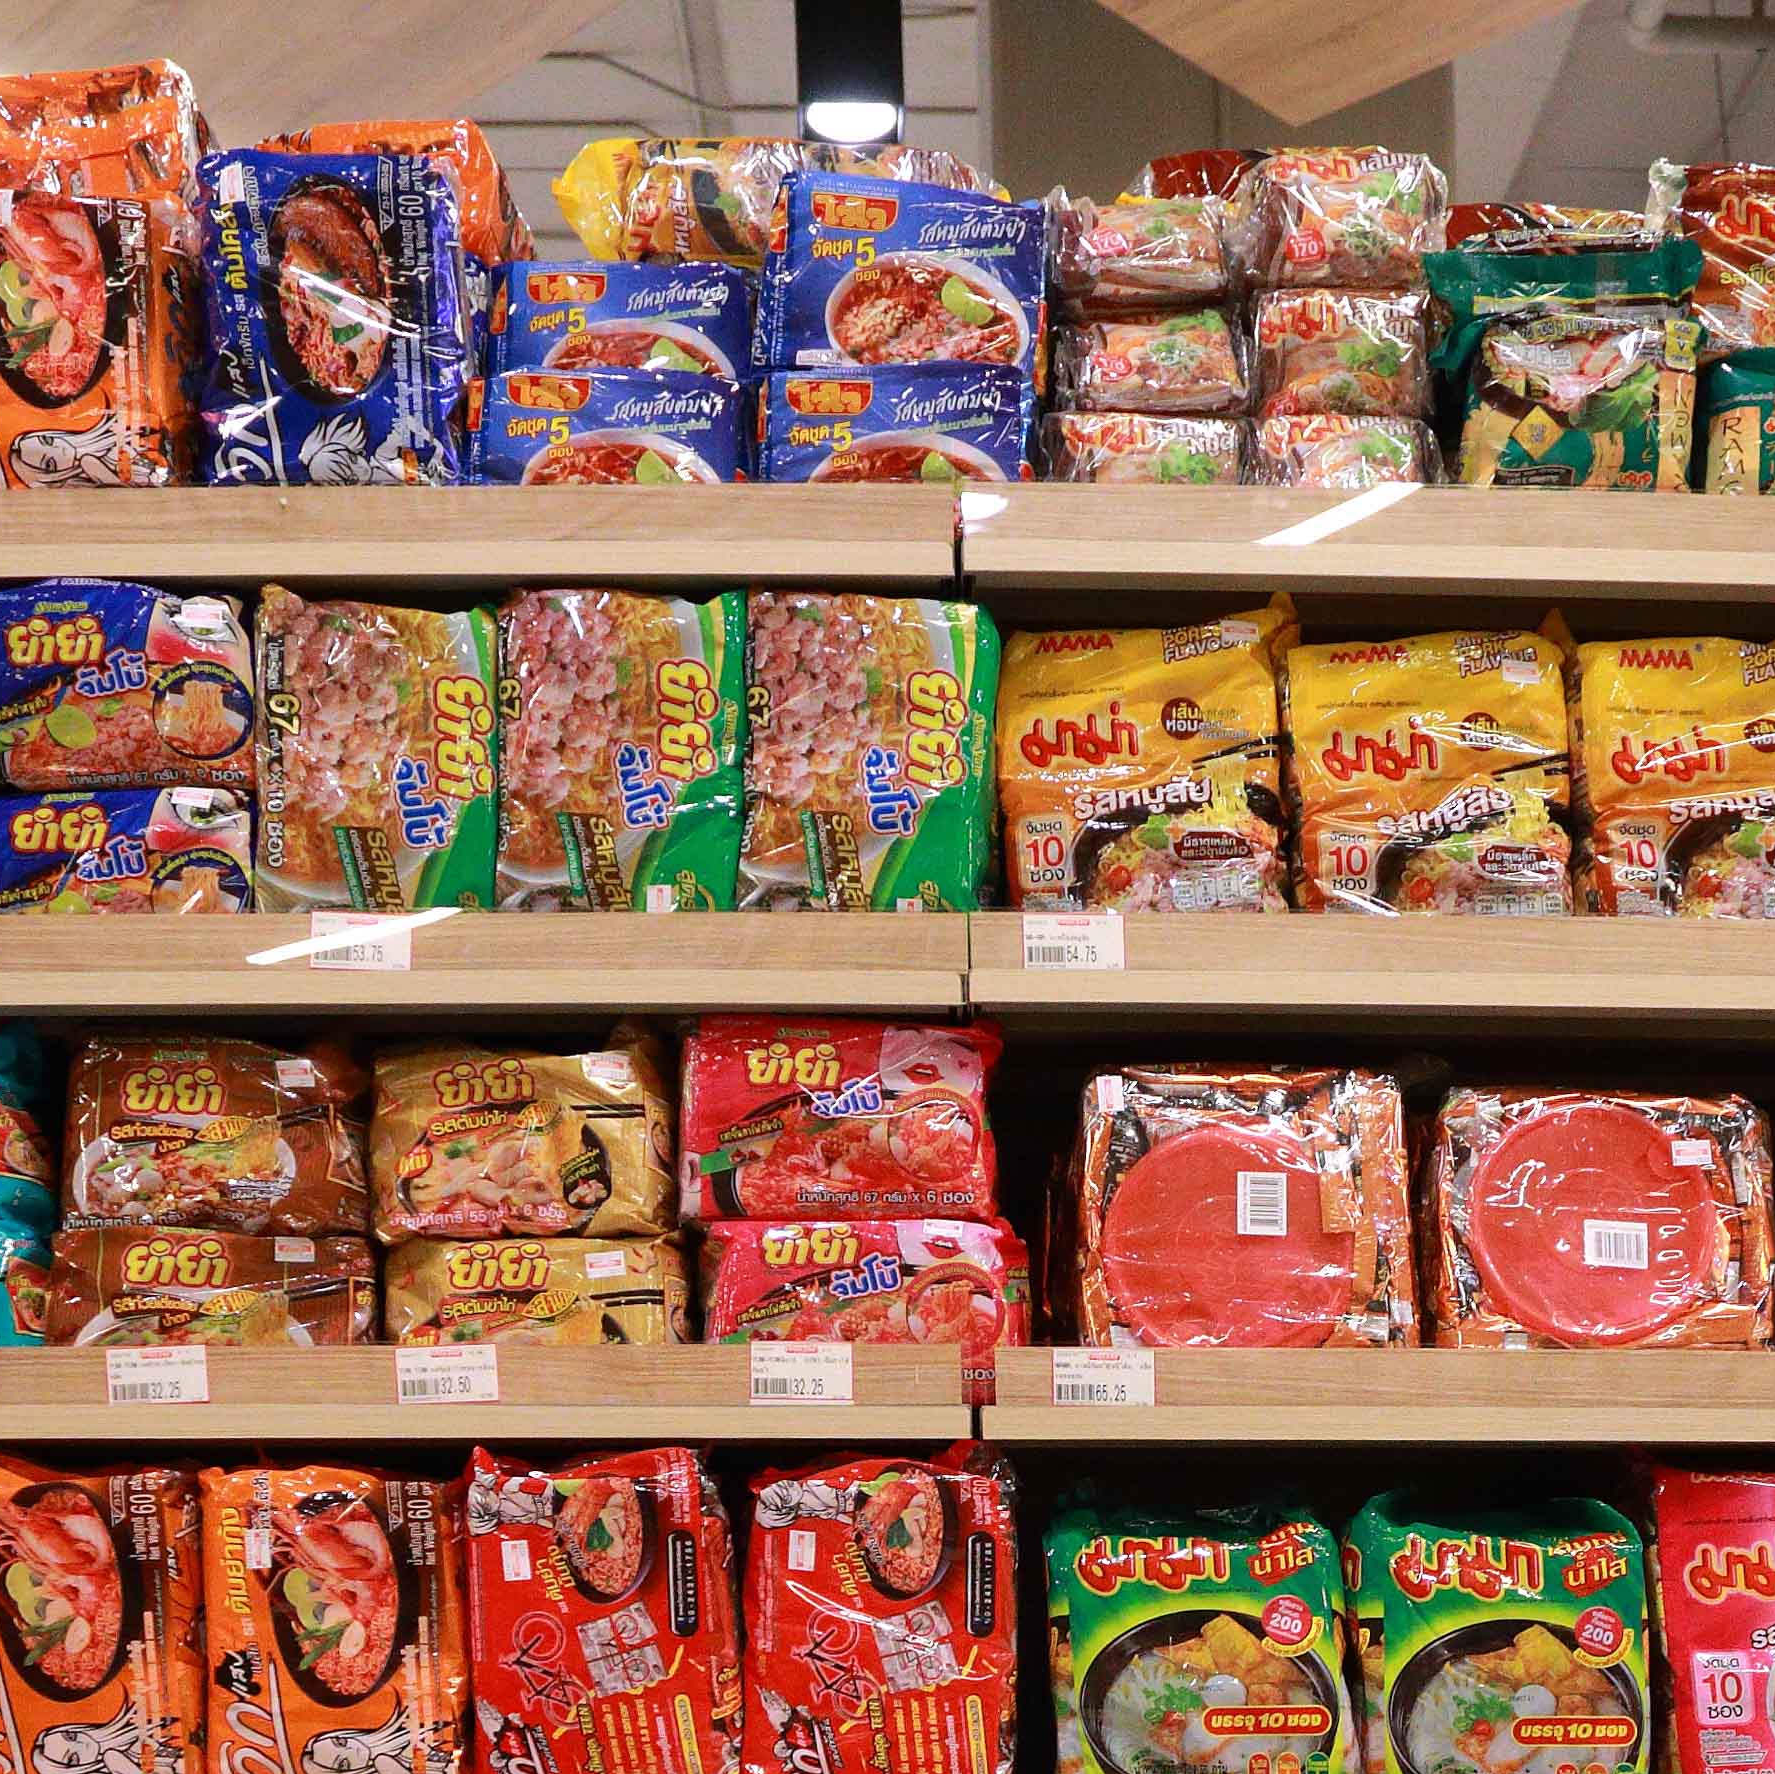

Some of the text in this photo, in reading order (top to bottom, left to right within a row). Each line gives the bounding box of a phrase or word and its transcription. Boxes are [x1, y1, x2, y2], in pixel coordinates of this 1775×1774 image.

[854, 236, 876, 266] 5
[548, 416, 570, 446] 5
[6, 618, 104, 666] ยำยำ
[1035, 633, 1114, 653] MAMA
[74, 651, 147, 698] จัมโบ้
[1618, 648, 1693, 671] MAMA
[270, 692, 301, 738] 67
[503, 679, 522, 720] 67
[1021, 701, 1139, 767] มาม่า
[1074, 777, 1212, 821] รสหมูสับ
[10, 802, 107, 852] ยำยำ
[1026, 835, 1064, 868] 10
[1067, 944, 1097, 963] 54.75
[123, 1063, 225, 1115] ยำยำ
[434, 1058, 535, 1108] ยำยำ
[124, 1239, 231, 1288] ยำยำ
[449, 1242, 551, 1290] ยำยำ
[829, 1253, 901, 1301] จัมโบ้
[150, 1381, 180, 1399] 32.25
[440, 1377, 471, 1394] 32.50
[793, 1377, 824, 1395] 32.25
[1095, 1383, 1127, 1403] 65.25
[1268, 1614, 1303, 1636] 200
[1581, 1624, 1614, 1646] 200
[1257, 1713, 1281, 1729] 10
[1284, 1712, 1324, 1729] ซอง
[1567, 1724, 1592, 1741] 10
